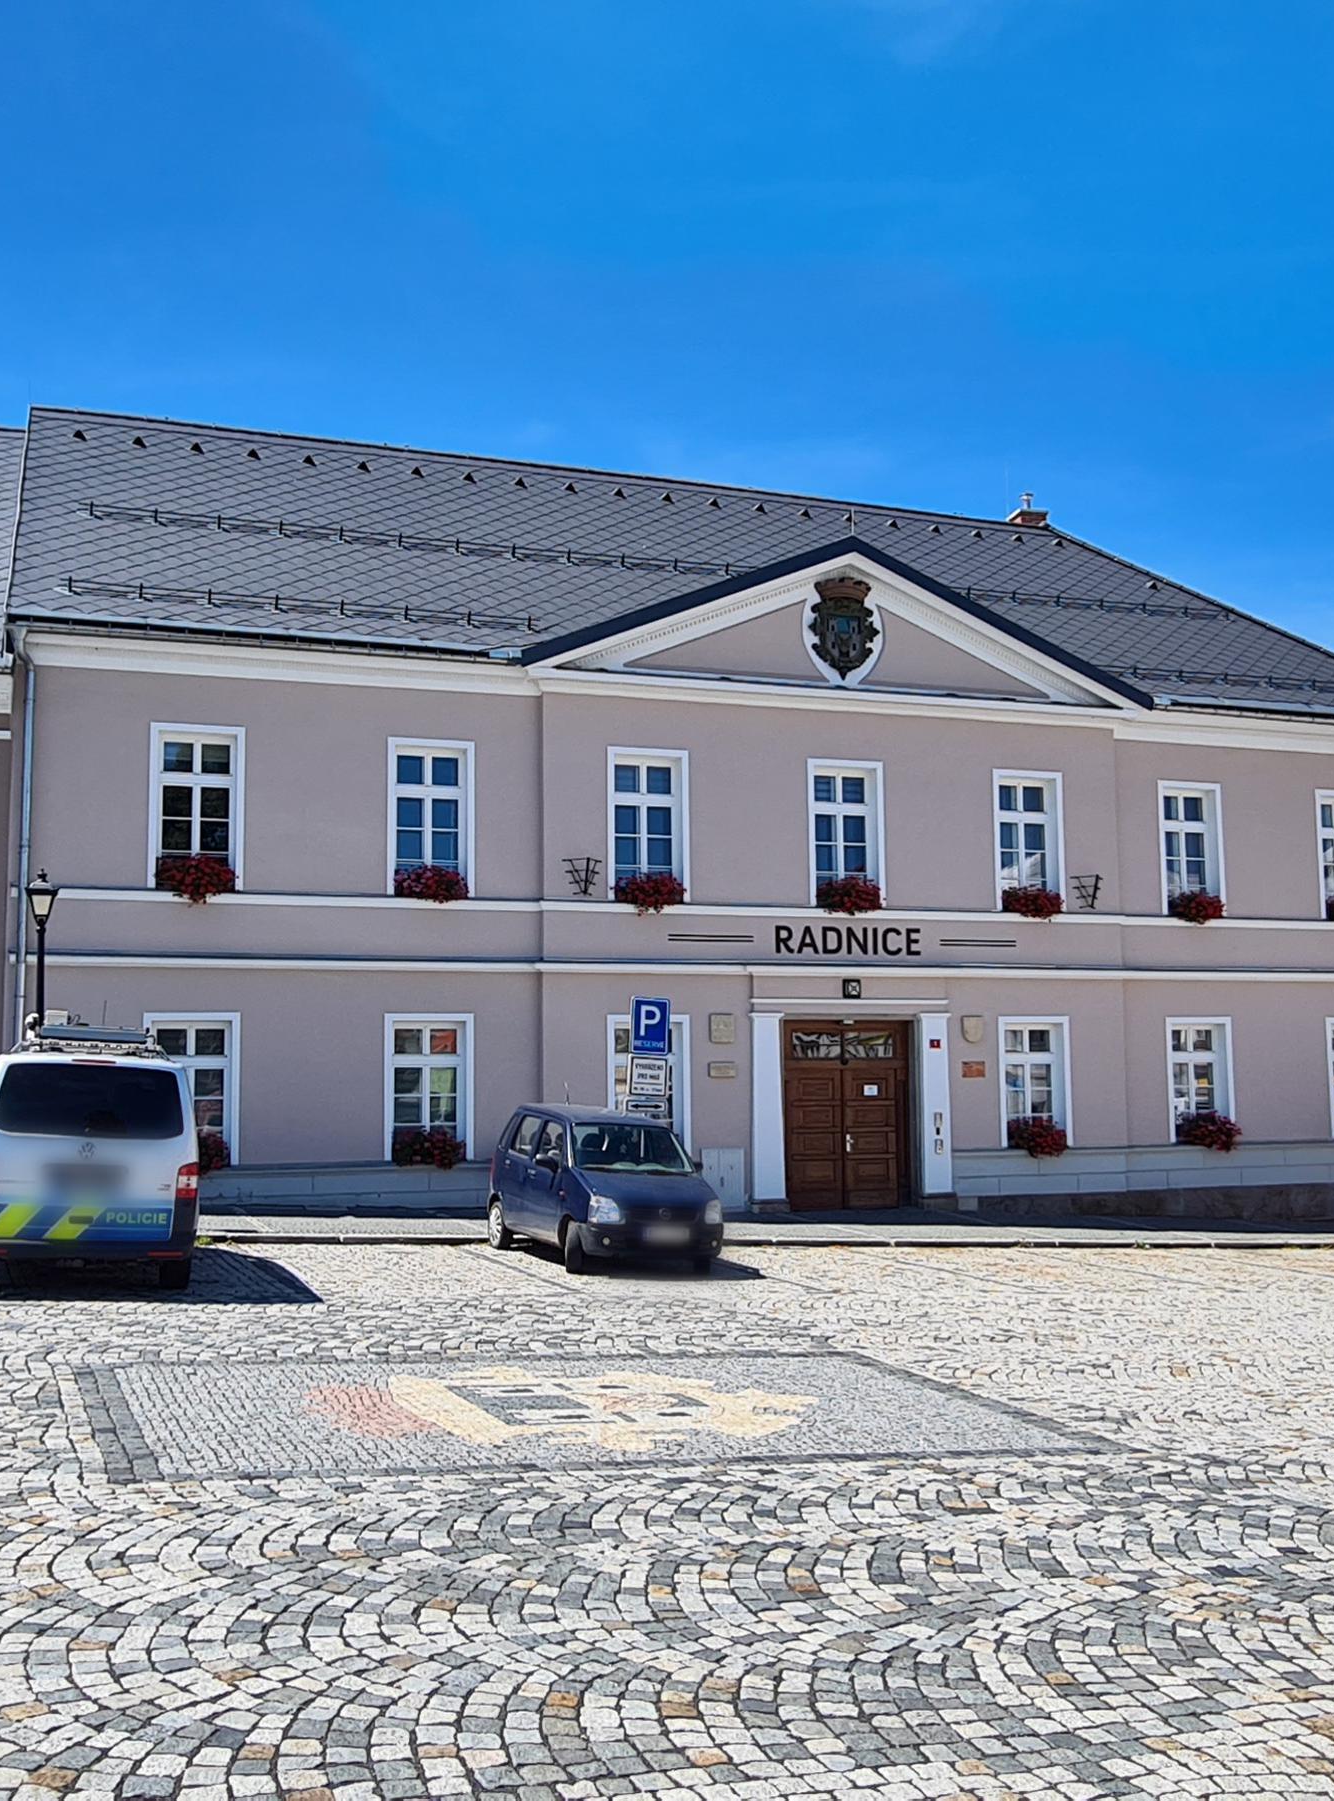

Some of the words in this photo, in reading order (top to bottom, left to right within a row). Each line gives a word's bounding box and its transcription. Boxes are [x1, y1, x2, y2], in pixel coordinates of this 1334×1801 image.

[774, 924, 922, 956] RADNICE
[639, 1005, 661, 1036] P
[106, 1212, 168, 1224] POLICIE
